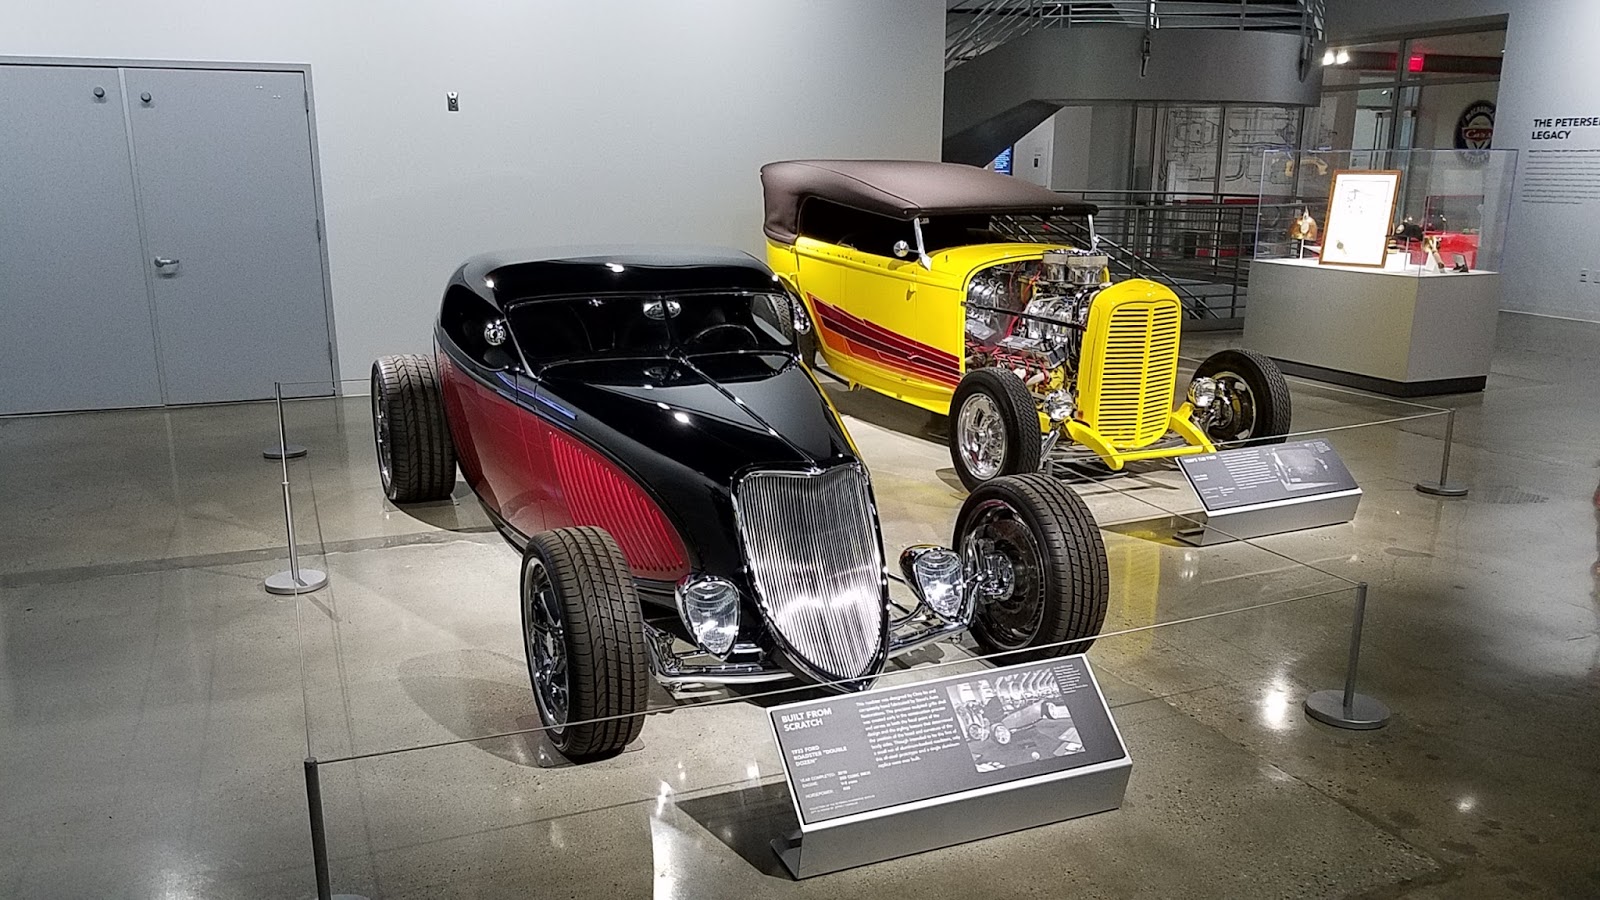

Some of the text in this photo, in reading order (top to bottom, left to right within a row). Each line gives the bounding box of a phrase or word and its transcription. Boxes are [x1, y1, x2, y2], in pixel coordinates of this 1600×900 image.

[1533, 117, 1600, 128] THE PETERSE
[1531, 130, 1572, 140] LEGACY
[781, 707, 832, 723] BUILT FROM
[783, 717, 824, 732] SCRATCH
[804, 745, 820, 753] FORD
[793, 750, 822, 761] ROADSTER
